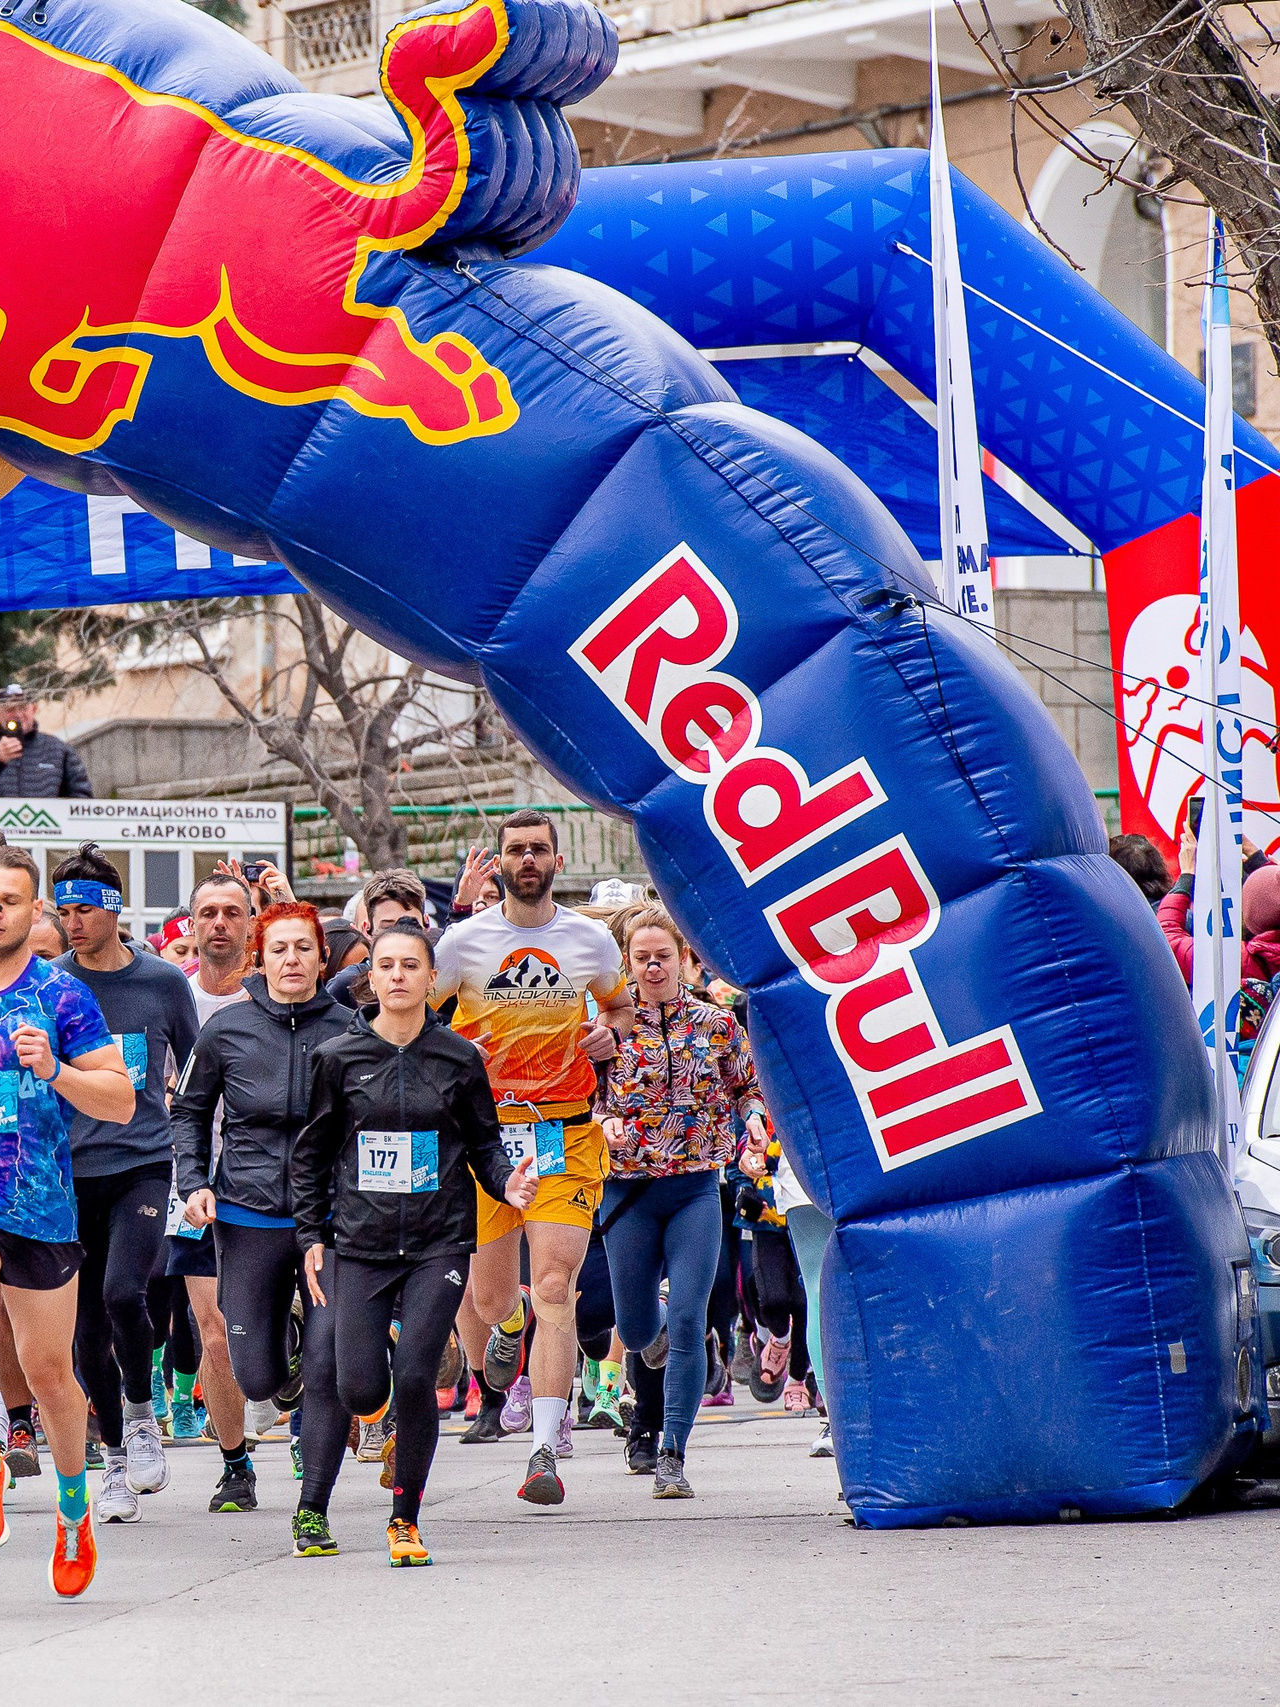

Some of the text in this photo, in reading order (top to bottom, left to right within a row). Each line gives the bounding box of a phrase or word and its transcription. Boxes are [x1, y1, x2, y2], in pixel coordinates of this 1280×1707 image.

[69, 804, 278, 821] ИНФОРМАЦИОННО ТАБЛО
[576, 551, 1025, 1162] Red Bull
[534, 1000, 567, 1009] RUN
[369, 1149, 398, 1169] 177
